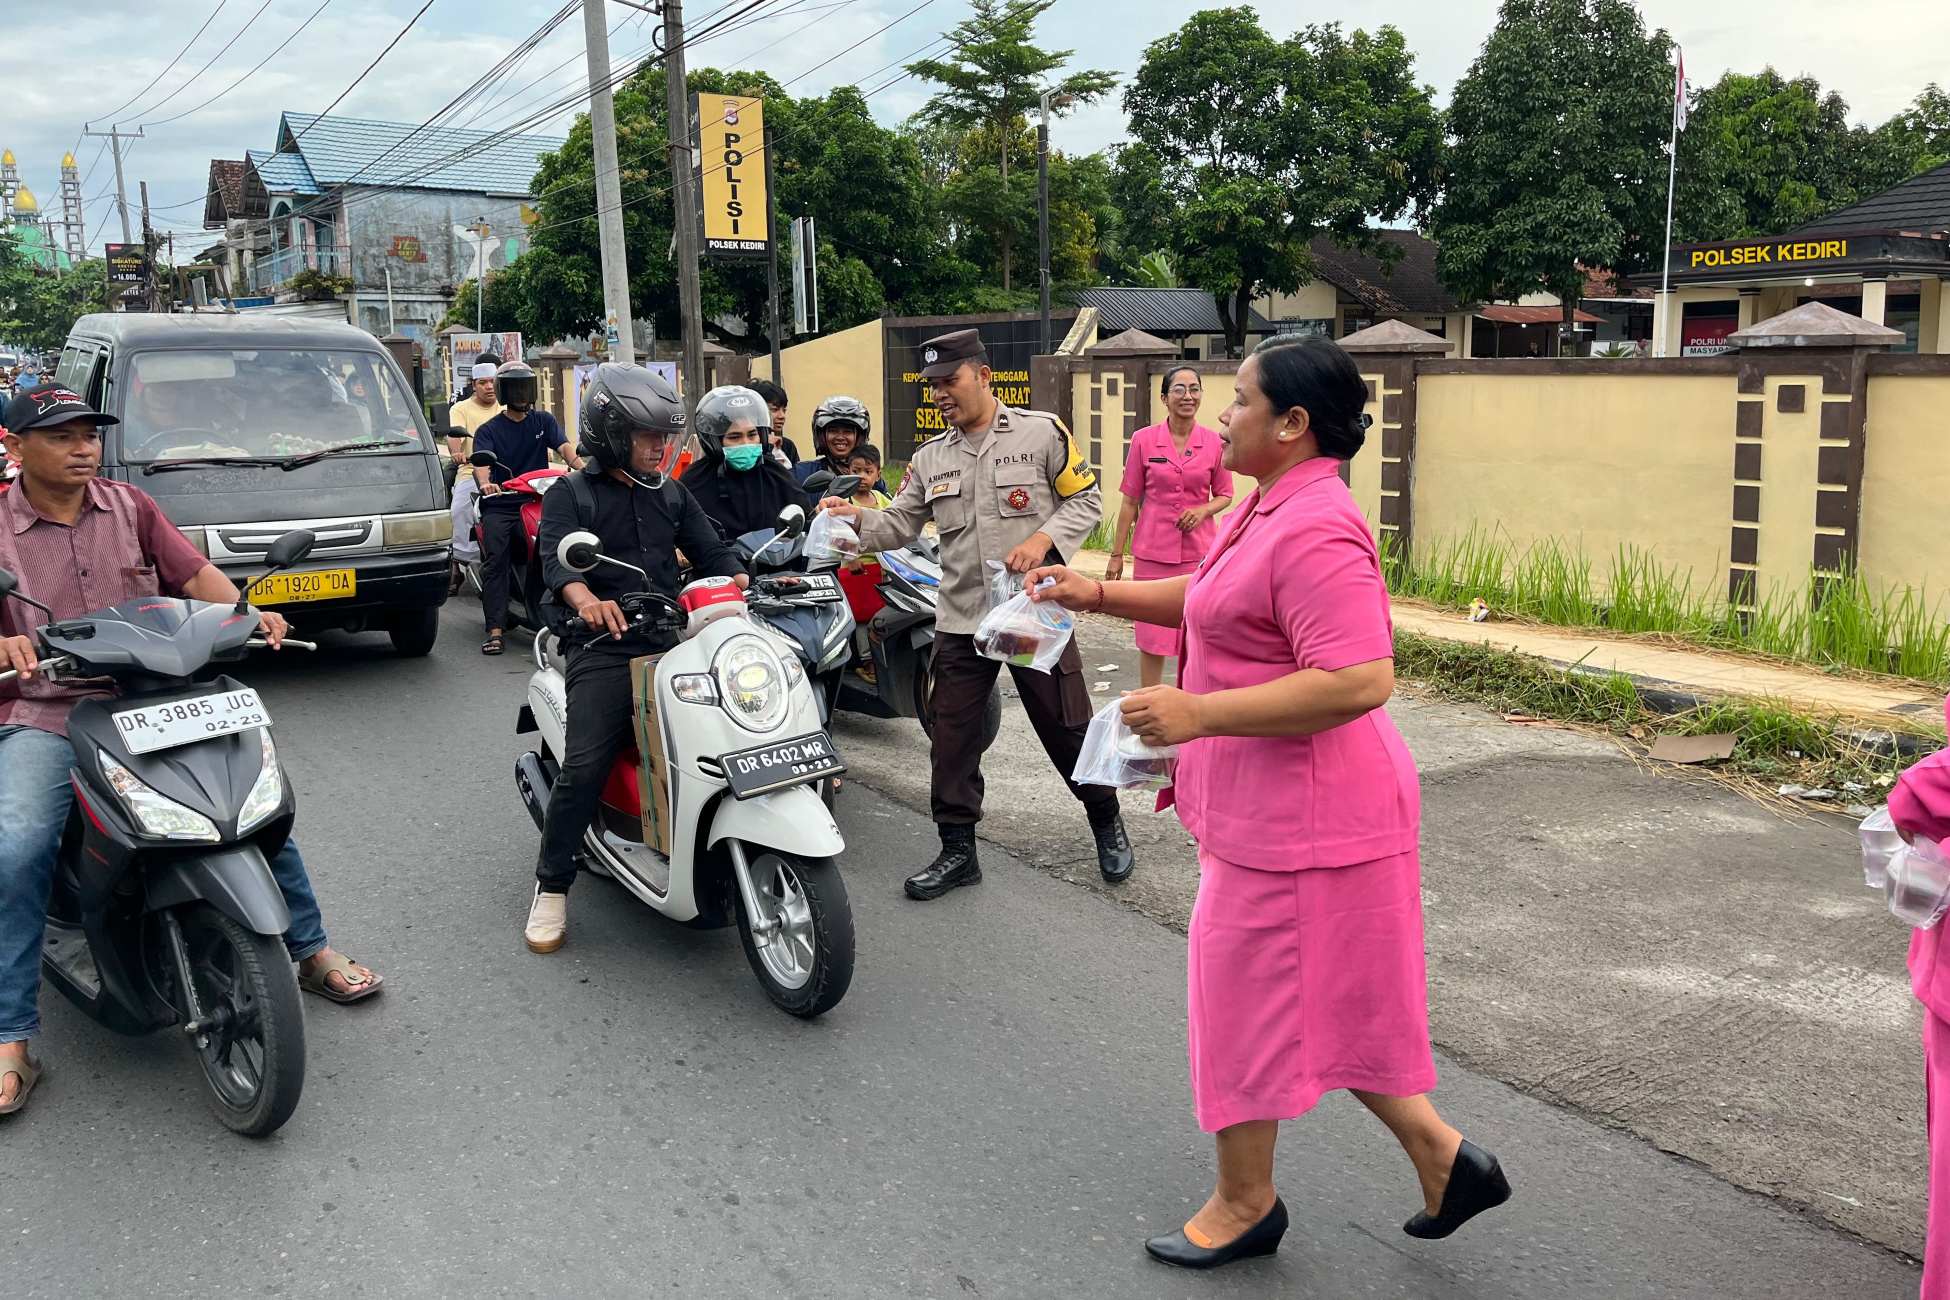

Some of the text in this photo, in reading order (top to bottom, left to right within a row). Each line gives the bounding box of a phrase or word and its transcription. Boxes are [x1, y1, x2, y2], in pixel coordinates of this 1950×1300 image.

[724, 132, 743, 235] POLISI
[709, 239, 765, 251] POLSEK KEDIRI
[1691, 240, 1847, 268] POLSEK KEDIRI
[1691, 338, 1716, 346] POLRI
[997, 386, 1031, 405] BARAT
[995, 453, 1033, 466] POLRI
[284, 575, 321, 593] 1920
[331, 573, 350, 590] DA
[119, 693, 254, 732] DR 3885 UC
[736, 741, 826, 774] DR 6402 MR
